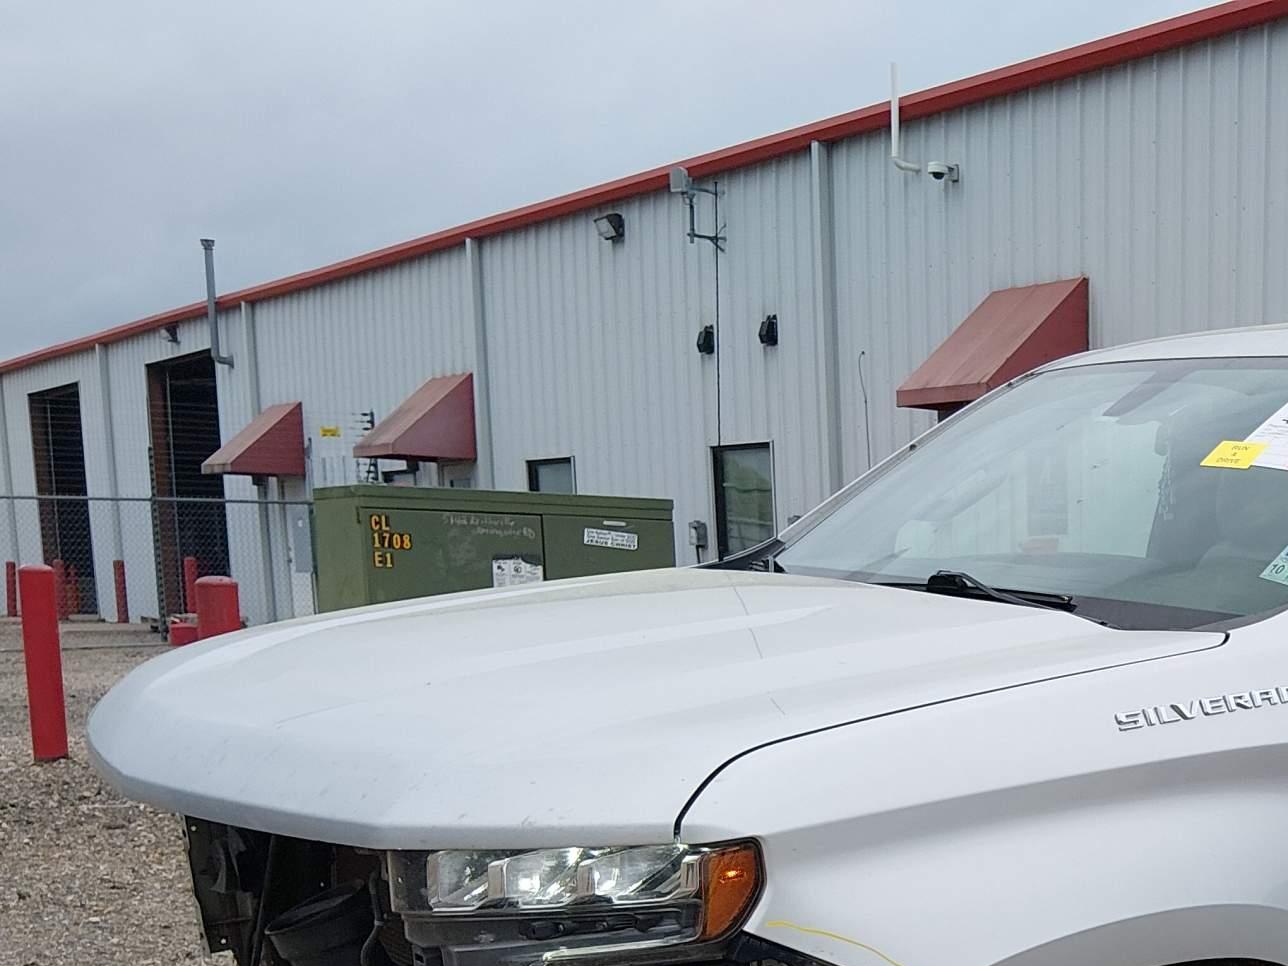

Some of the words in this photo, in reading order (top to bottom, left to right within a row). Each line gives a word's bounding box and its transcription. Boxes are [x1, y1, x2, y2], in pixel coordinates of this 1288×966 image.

[371, 514, 390, 530] CL
[373, 533, 412, 549] 1708
[374, 551, 393, 568] E1
[1270, 563, 1286, 575] 10
